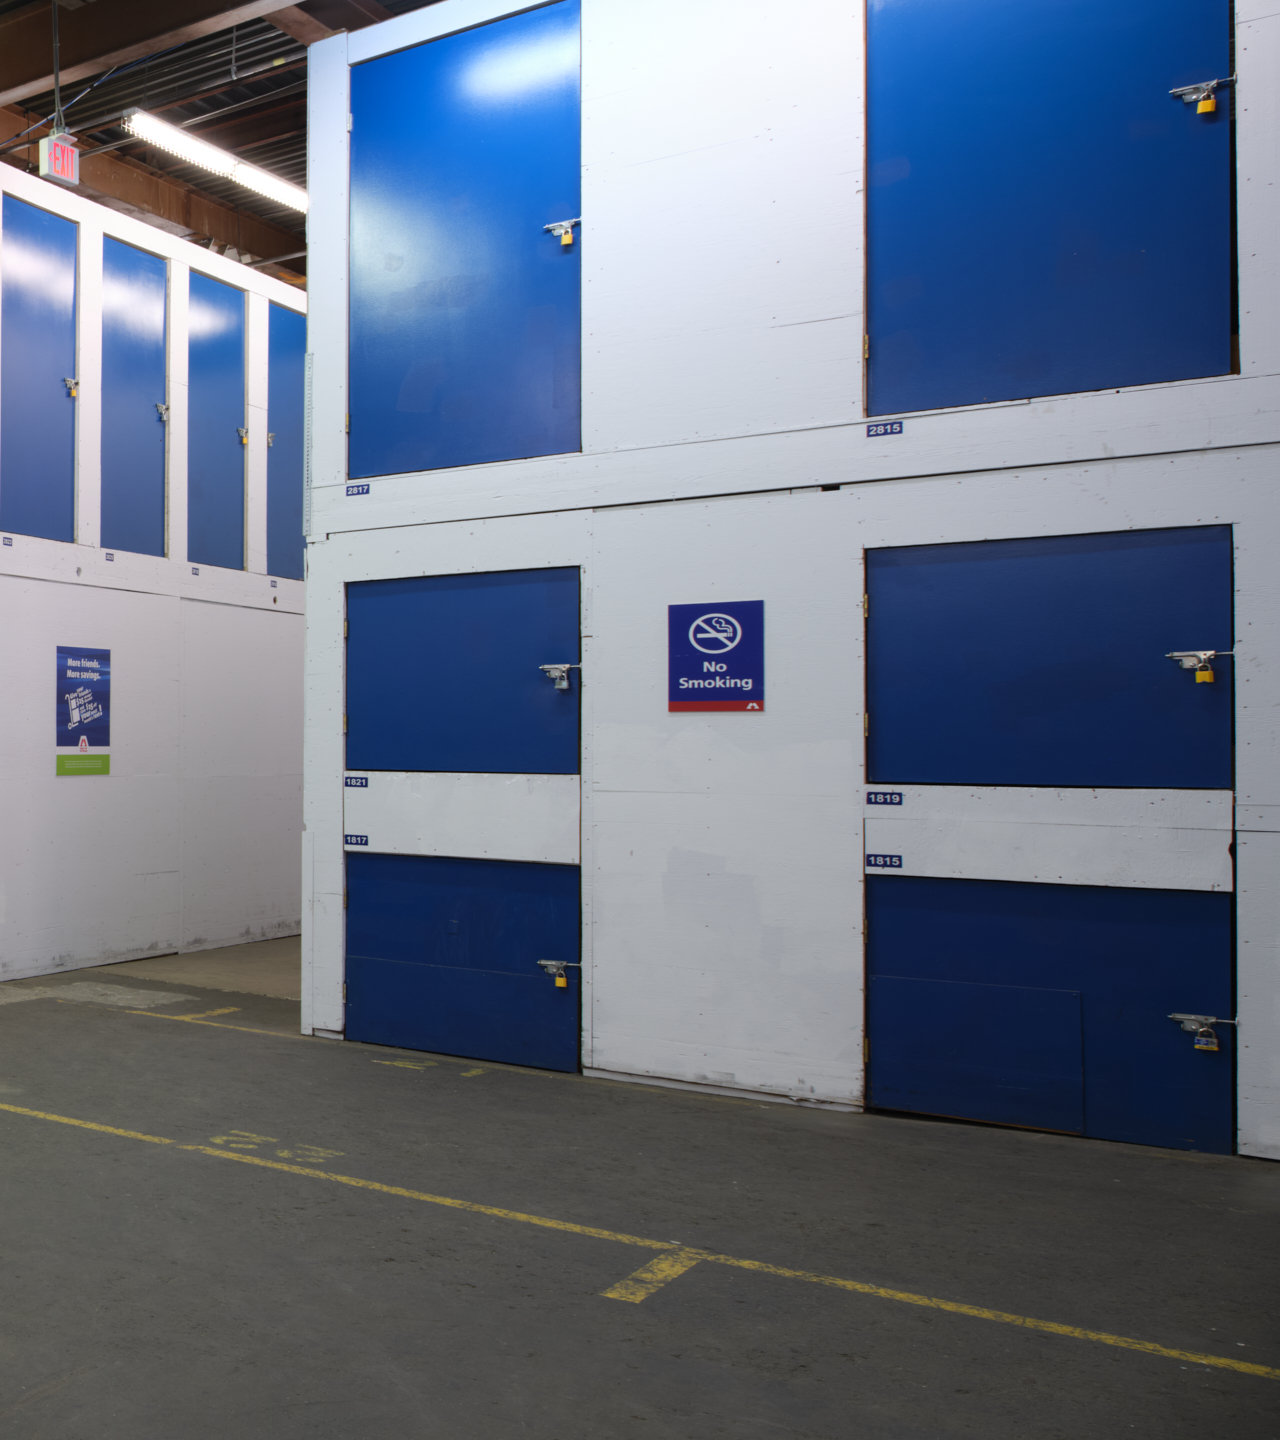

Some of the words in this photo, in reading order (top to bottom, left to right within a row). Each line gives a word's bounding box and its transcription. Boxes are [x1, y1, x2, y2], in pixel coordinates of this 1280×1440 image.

[53, 141, 76, 180] EXIT
[868, 423, 901, 436] 2815
[347, 485, 369, 496] 2817
[67, 657, 81, 667] More
[81, 658, 101, 668] friends.
[702, 661, 728, 673] No
[66, 669, 80, 678] More
[80, 670, 102, 681] savings.
[678, 675, 754, 691] Smoking
[346, 778, 366, 786] 1821
[868, 793, 901, 803] 1819
[346, 836, 367, 845] 1817
[868, 856, 900, 866] 1815
